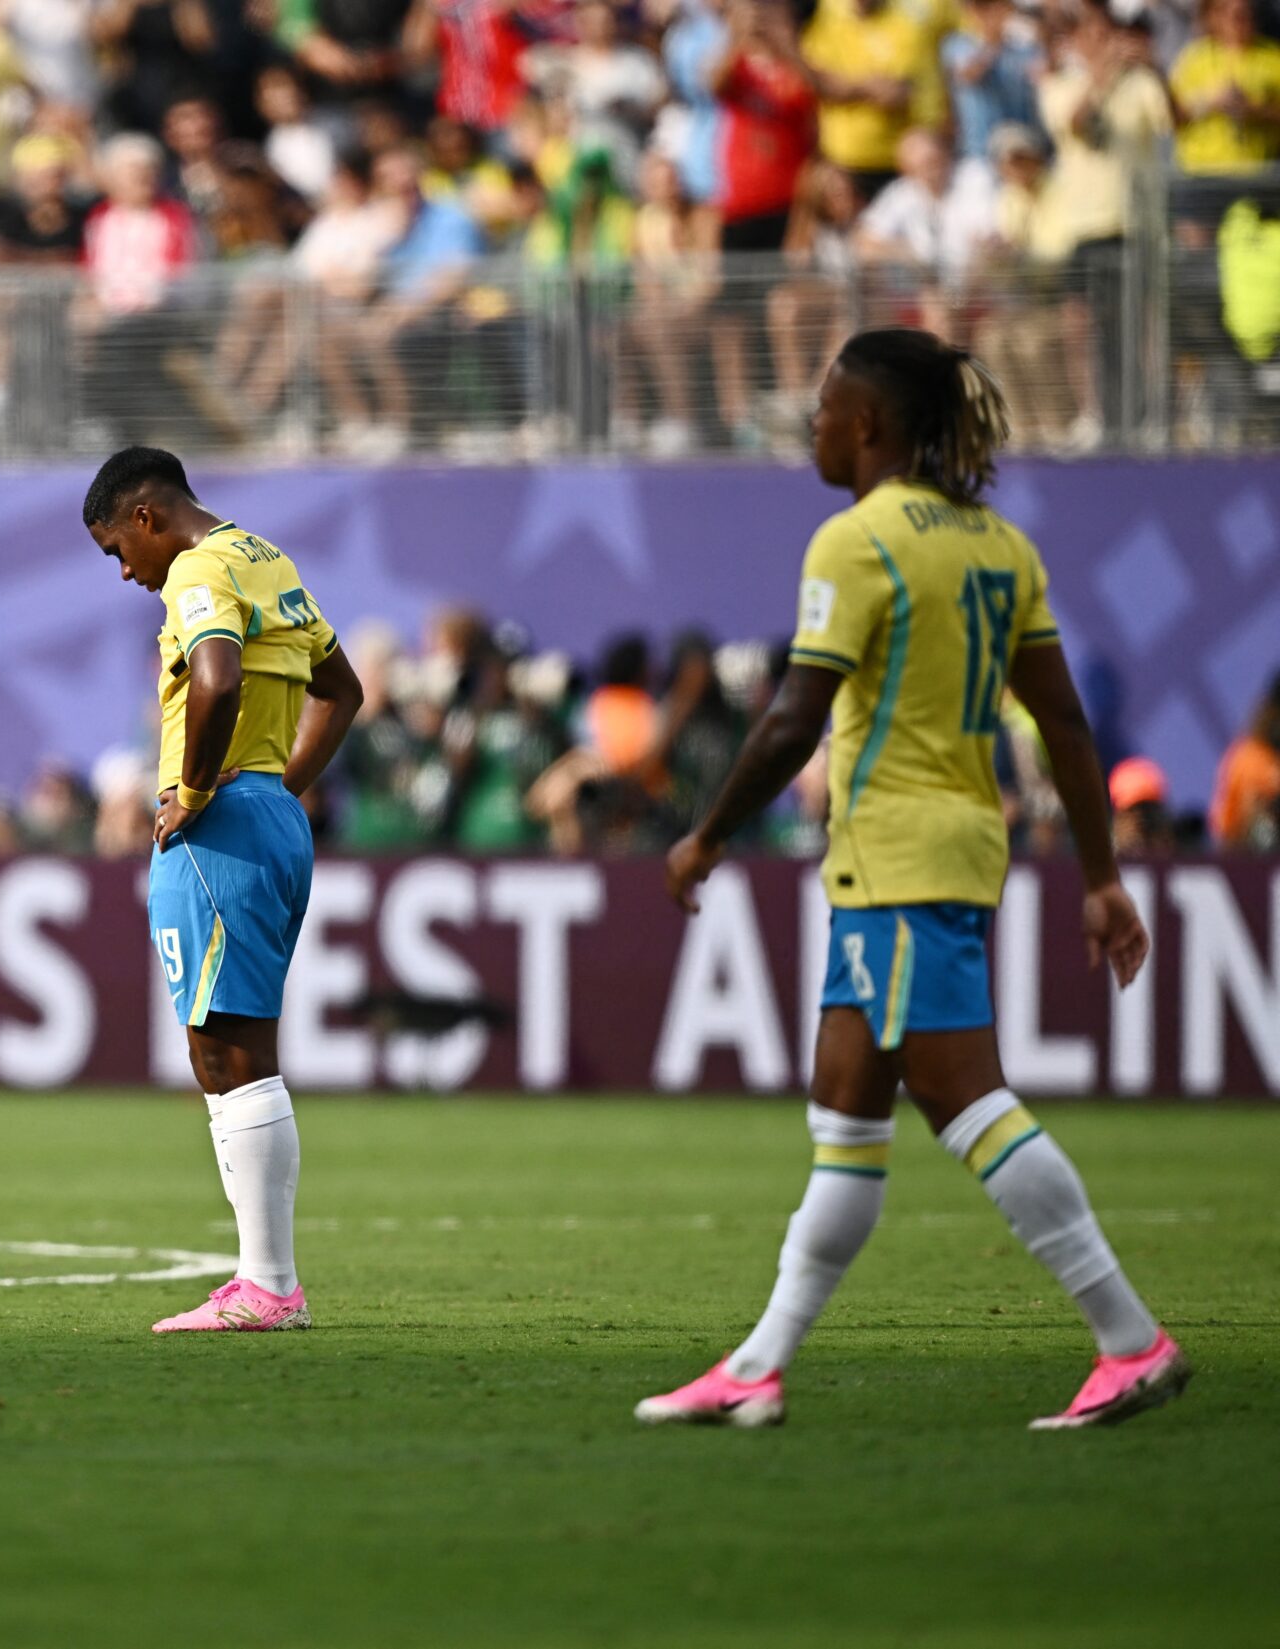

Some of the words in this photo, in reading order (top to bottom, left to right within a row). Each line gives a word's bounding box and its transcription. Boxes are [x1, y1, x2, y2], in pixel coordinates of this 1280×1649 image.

[957, 567, 1017, 733] 18
[134, 857, 605, 1092] EST
[155, 928, 184, 983] 19
